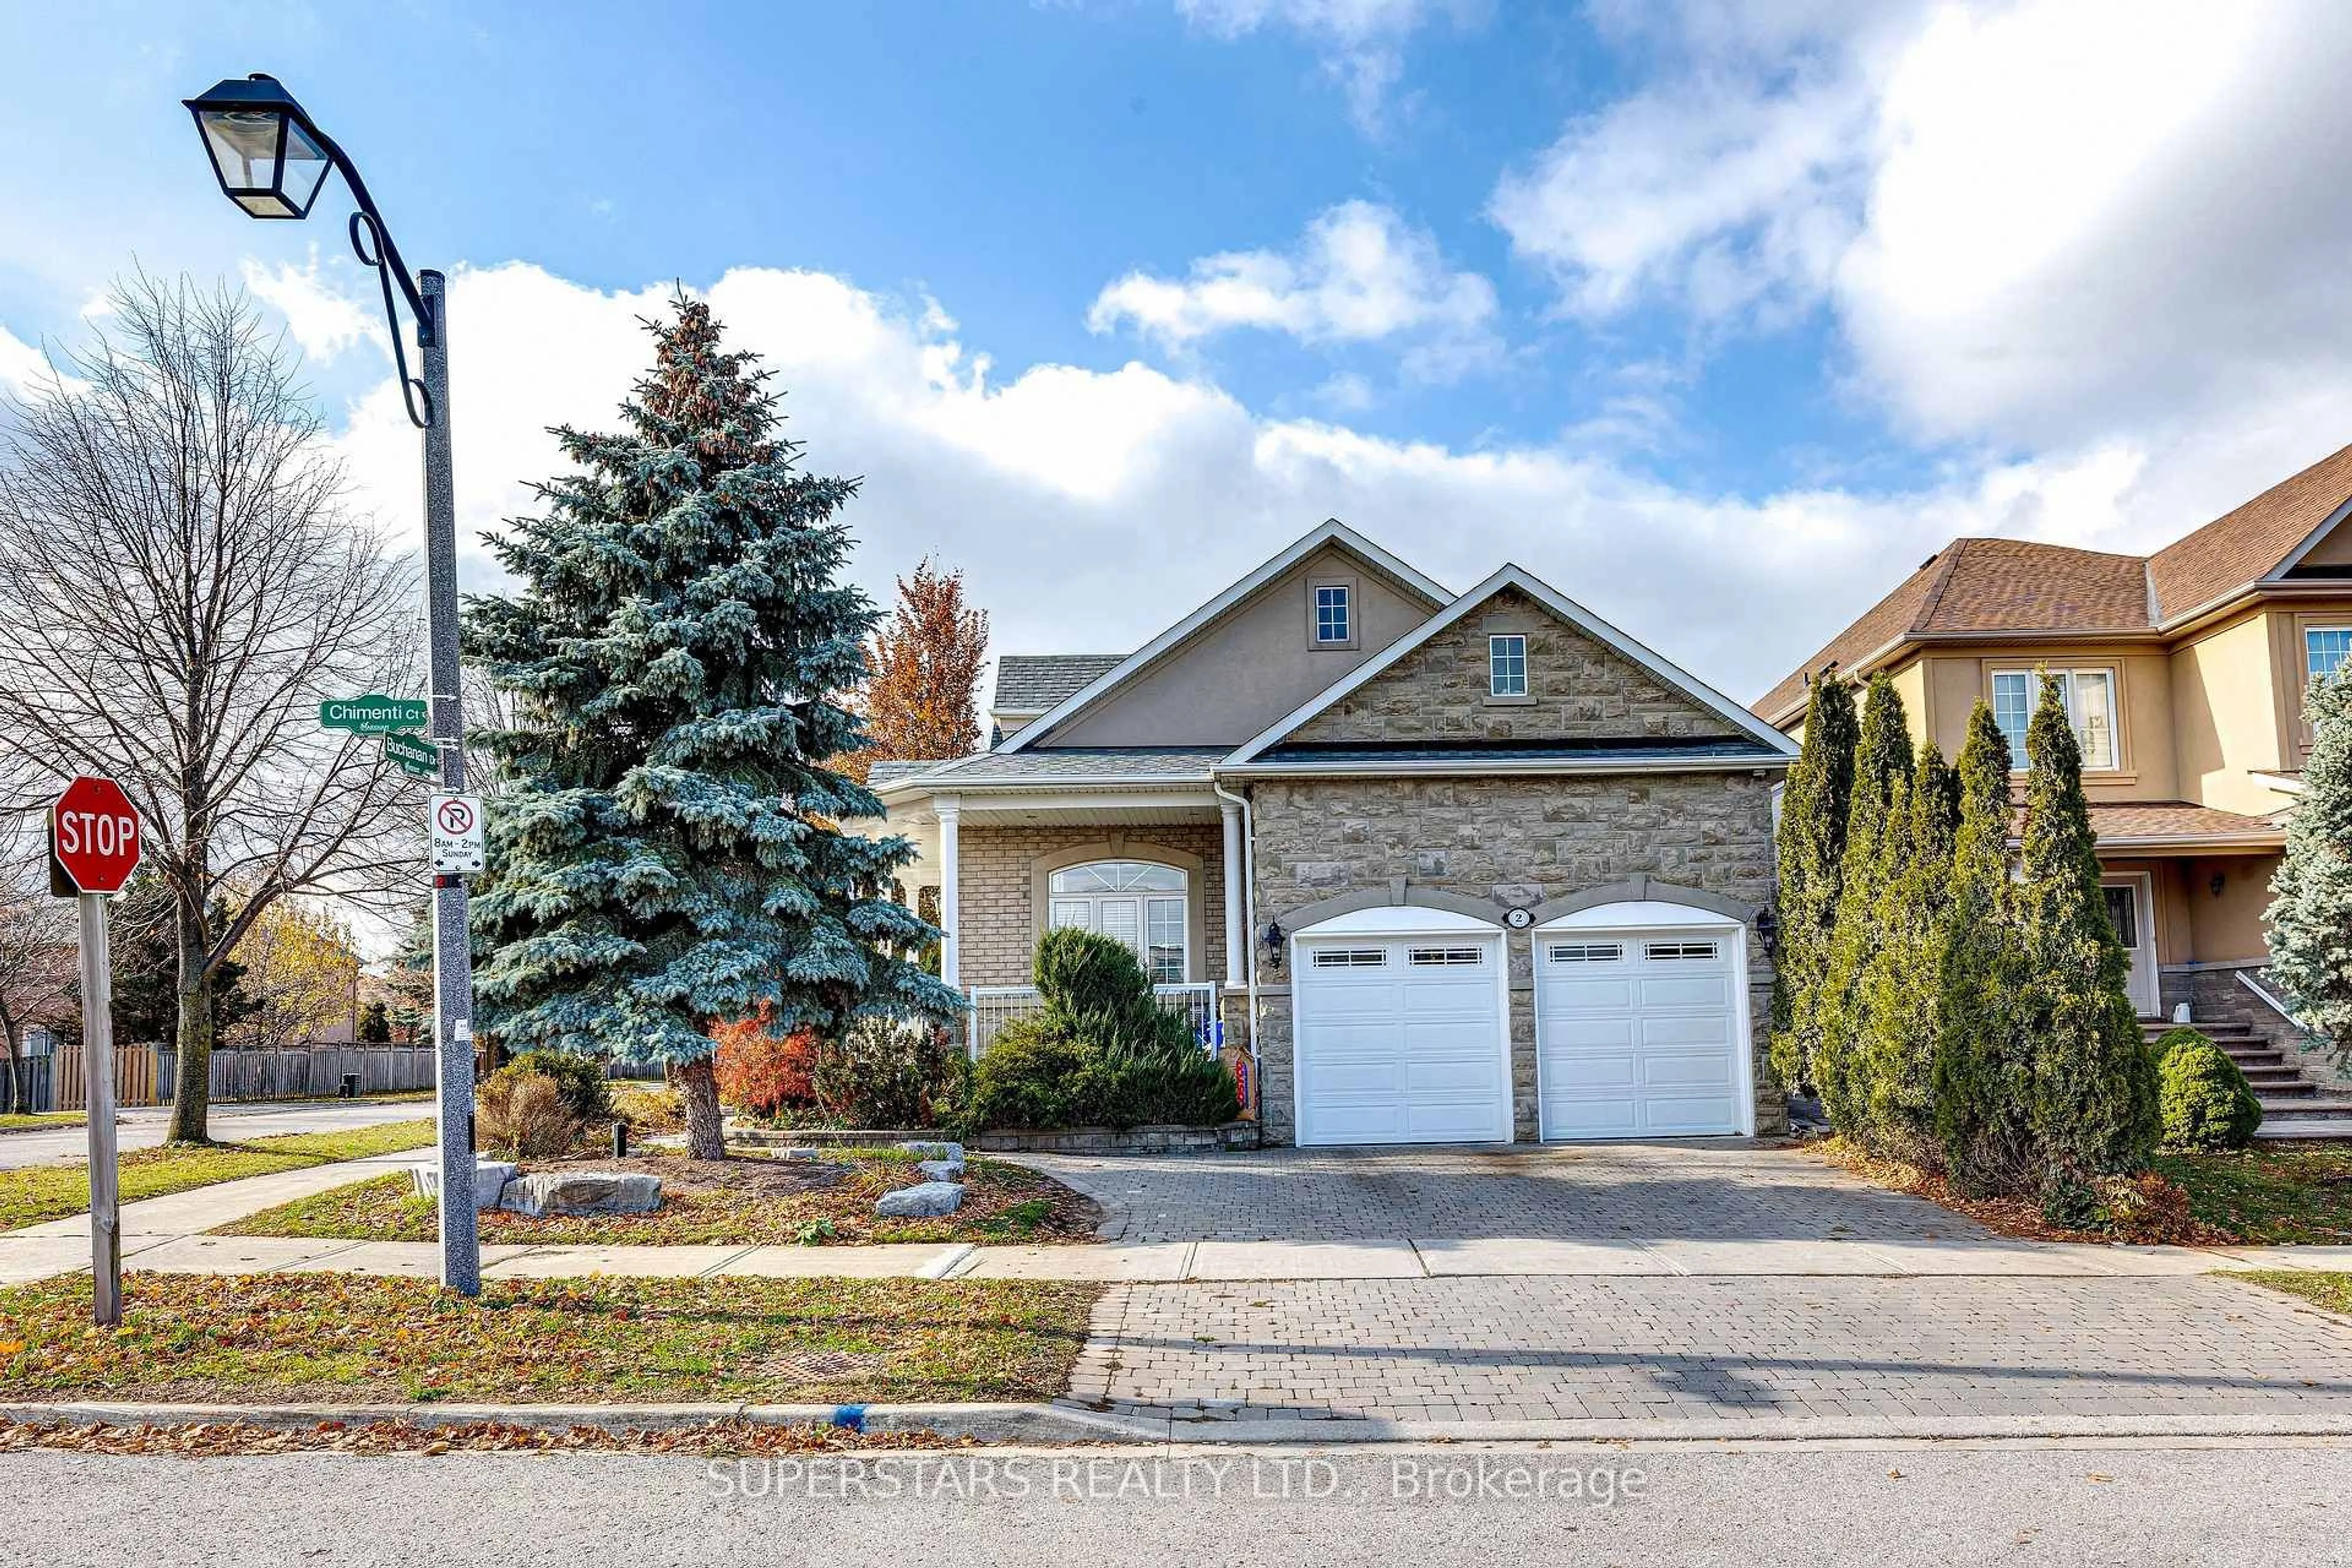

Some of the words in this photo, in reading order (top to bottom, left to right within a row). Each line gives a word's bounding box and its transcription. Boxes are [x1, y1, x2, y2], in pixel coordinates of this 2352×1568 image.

[330, 705, 402, 720] Chimenti
[387, 737, 428, 764] Buchanan
[62, 810, 135, 856] STOP
[434, 838, 453, 848] 8AM
[461, 839, 480, 848] 2PM
